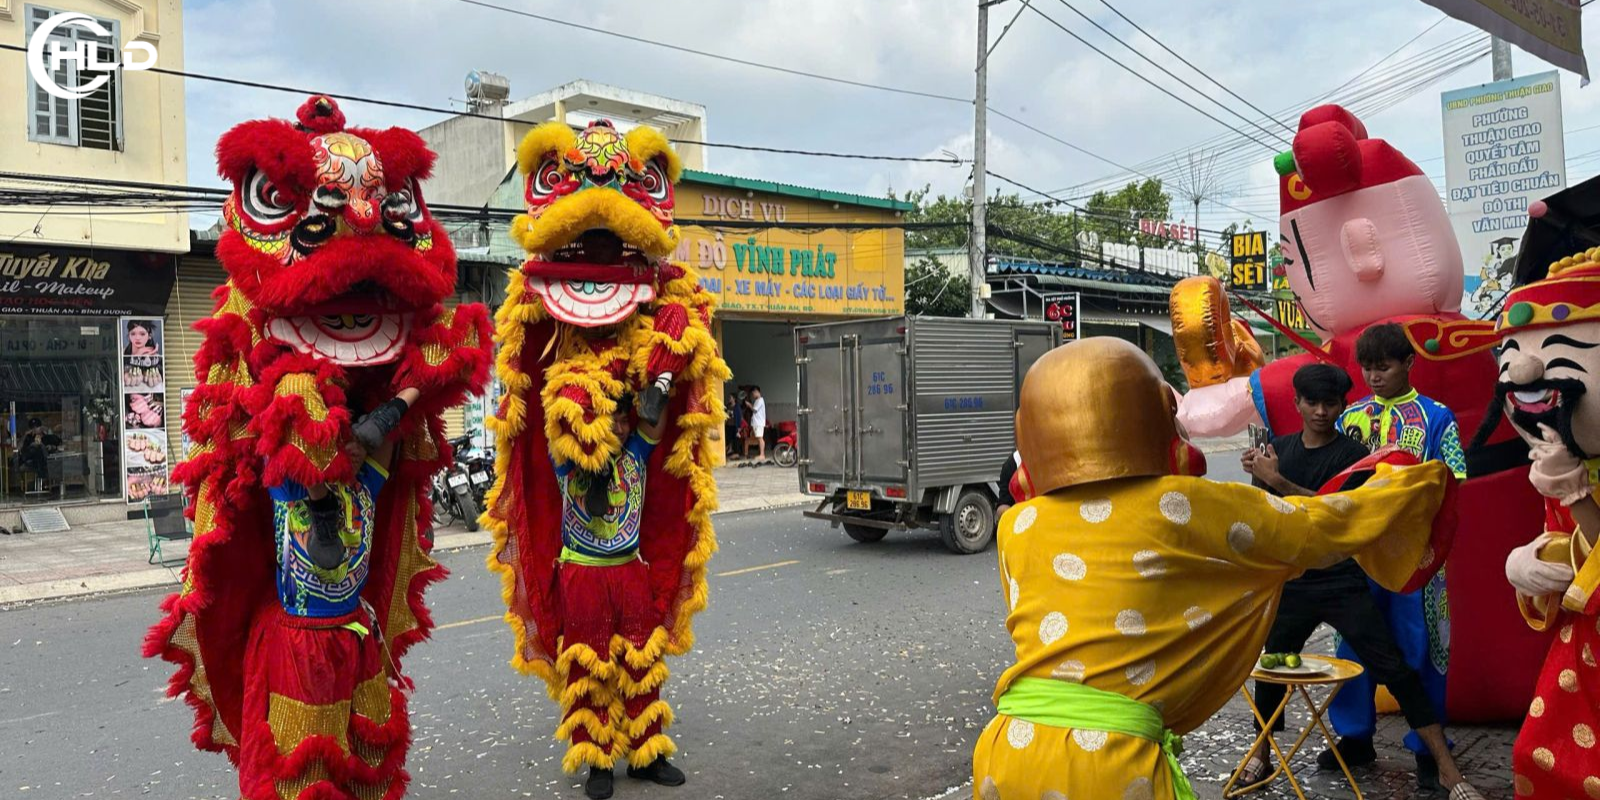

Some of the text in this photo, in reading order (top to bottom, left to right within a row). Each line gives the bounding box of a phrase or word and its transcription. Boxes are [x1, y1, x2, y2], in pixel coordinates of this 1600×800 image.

[1447, 97, 1470, 110] UBND
[1504, 84, 1532, 99] THUẬN
[1533, 82, 1554, 94] GIAO
[1472, 105, 1528, 128] PHƯỜNG
[1462, 122, 1541, 147] THUẬN GIAO
[1465, 139, 1541, 165] QUYẾT TÂM
[1469, 156, 1539, 180] PHẤN ĐẤU
[1451, 171, 1560, 202] ĐẠT TIÊU CHUẨN
[702, 194, 754, 220] DỊCH
[1483, 195, 1528, 214] ĐÔ THỊ
[1139, 218, 1167, 238] BIA
[1472, 214, 1530, 233] VĂN MIN
[1233, 233, 1265, 257] BIA
[0, 252, 111, 280] Tuyết Kha
[733, 237, 785, 275] VĨNH
[790, 243, 837, 278] PHÁT
[1232, 257, 1265, 290] SỆT
[35, 281, 115, 299] Makeup
[735, 279, 752, 295] XE
[755, 278, 782, 297] MÁY
[793, 281, 816, 298] CÁC
[818, 285, 843, 302] LOẠI
[846, 281, 870, 300] GIẤY
[872, 372, 885, 381] 61C
